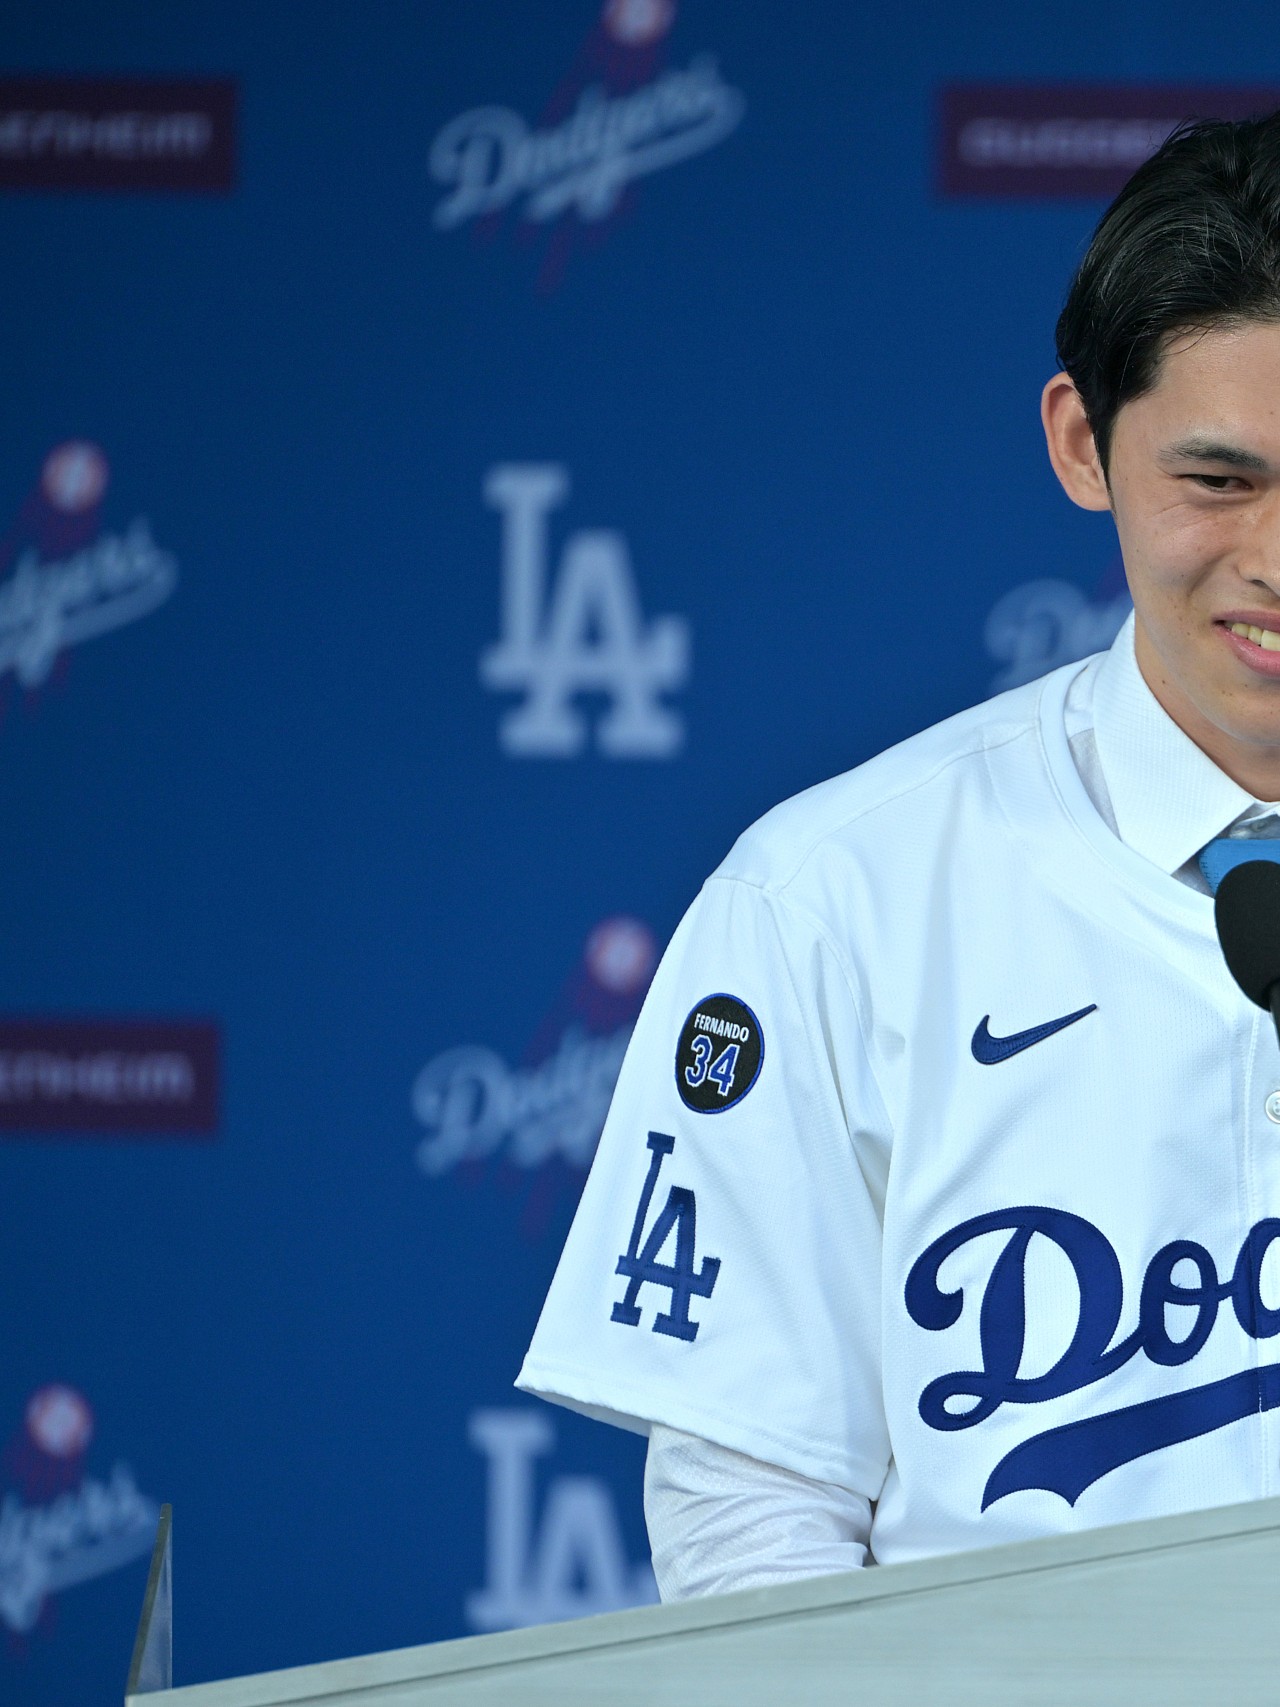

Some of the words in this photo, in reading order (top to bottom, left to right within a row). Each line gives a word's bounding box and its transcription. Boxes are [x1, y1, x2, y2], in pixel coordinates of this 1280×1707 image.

[481, 464, 690, 758] LA
[685, 1035, 740, 1097] 34
[694, 1013, 750, 1043] FERNANDO
[610, 1131, 721, 1342] LA
